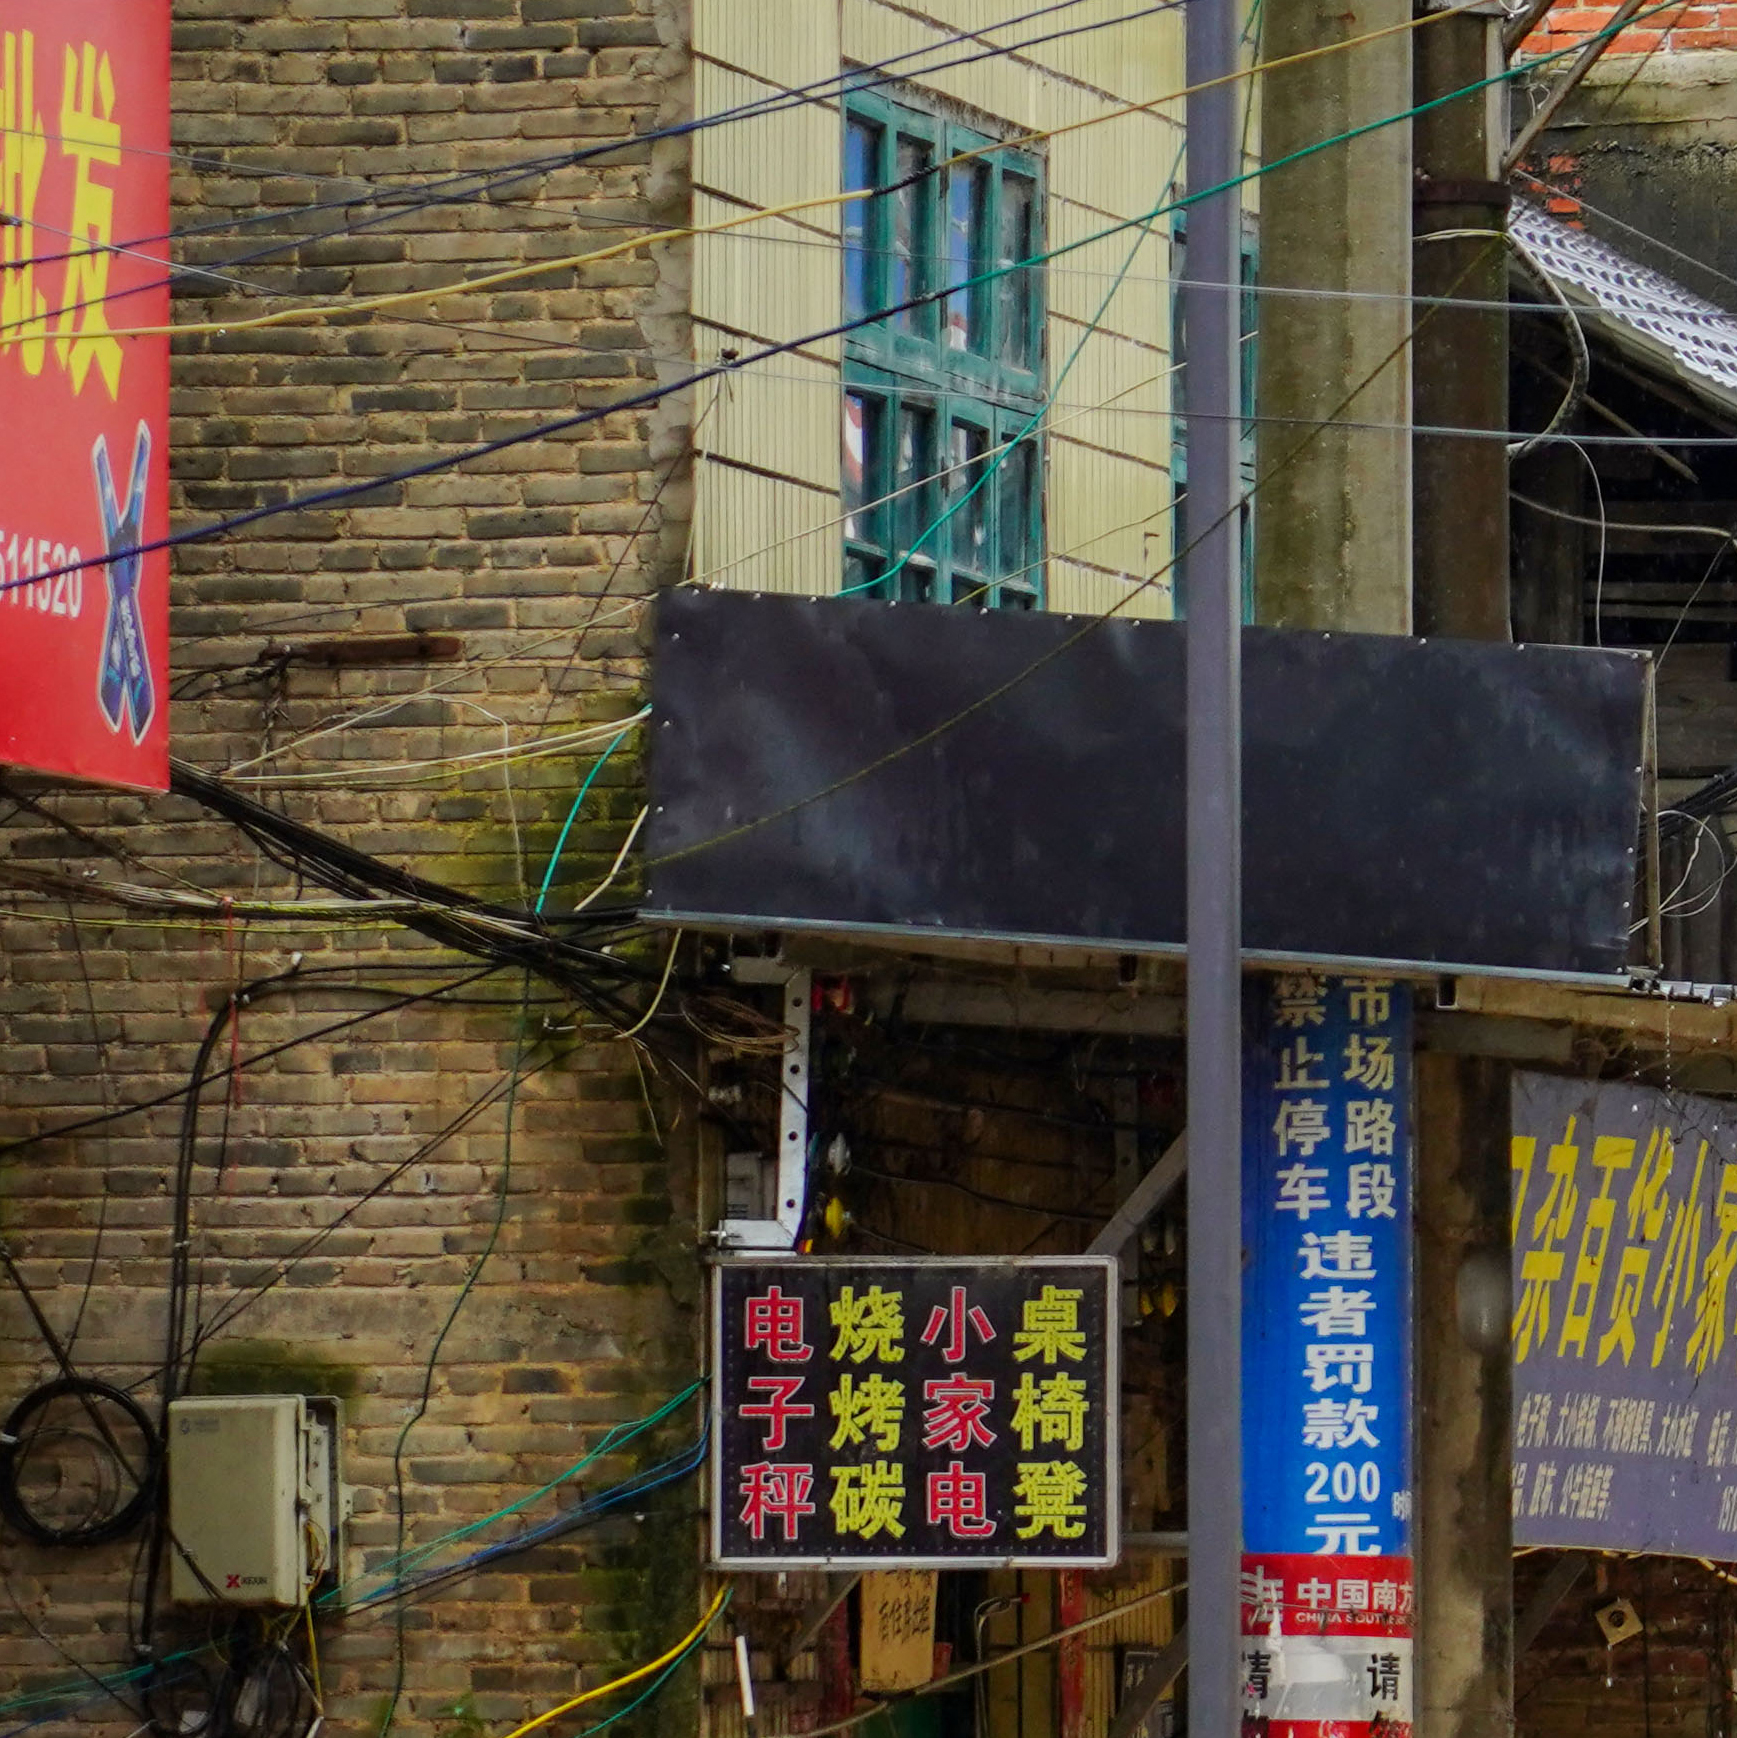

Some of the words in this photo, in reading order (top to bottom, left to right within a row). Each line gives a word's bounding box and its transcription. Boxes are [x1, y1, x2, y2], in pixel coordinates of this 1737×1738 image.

[1272, 974, 1332, 1220] 禁止停车
[1343, 977, 1397, 1219] 市场路段
[738, 1285, 816, 1541] 电子秤
[828, 1285, 906, 1540] 烧烤碳
[919, 1285, 998, 1540] 小家电
[1009, 1284, 1090, 1540] 桌椅凳
